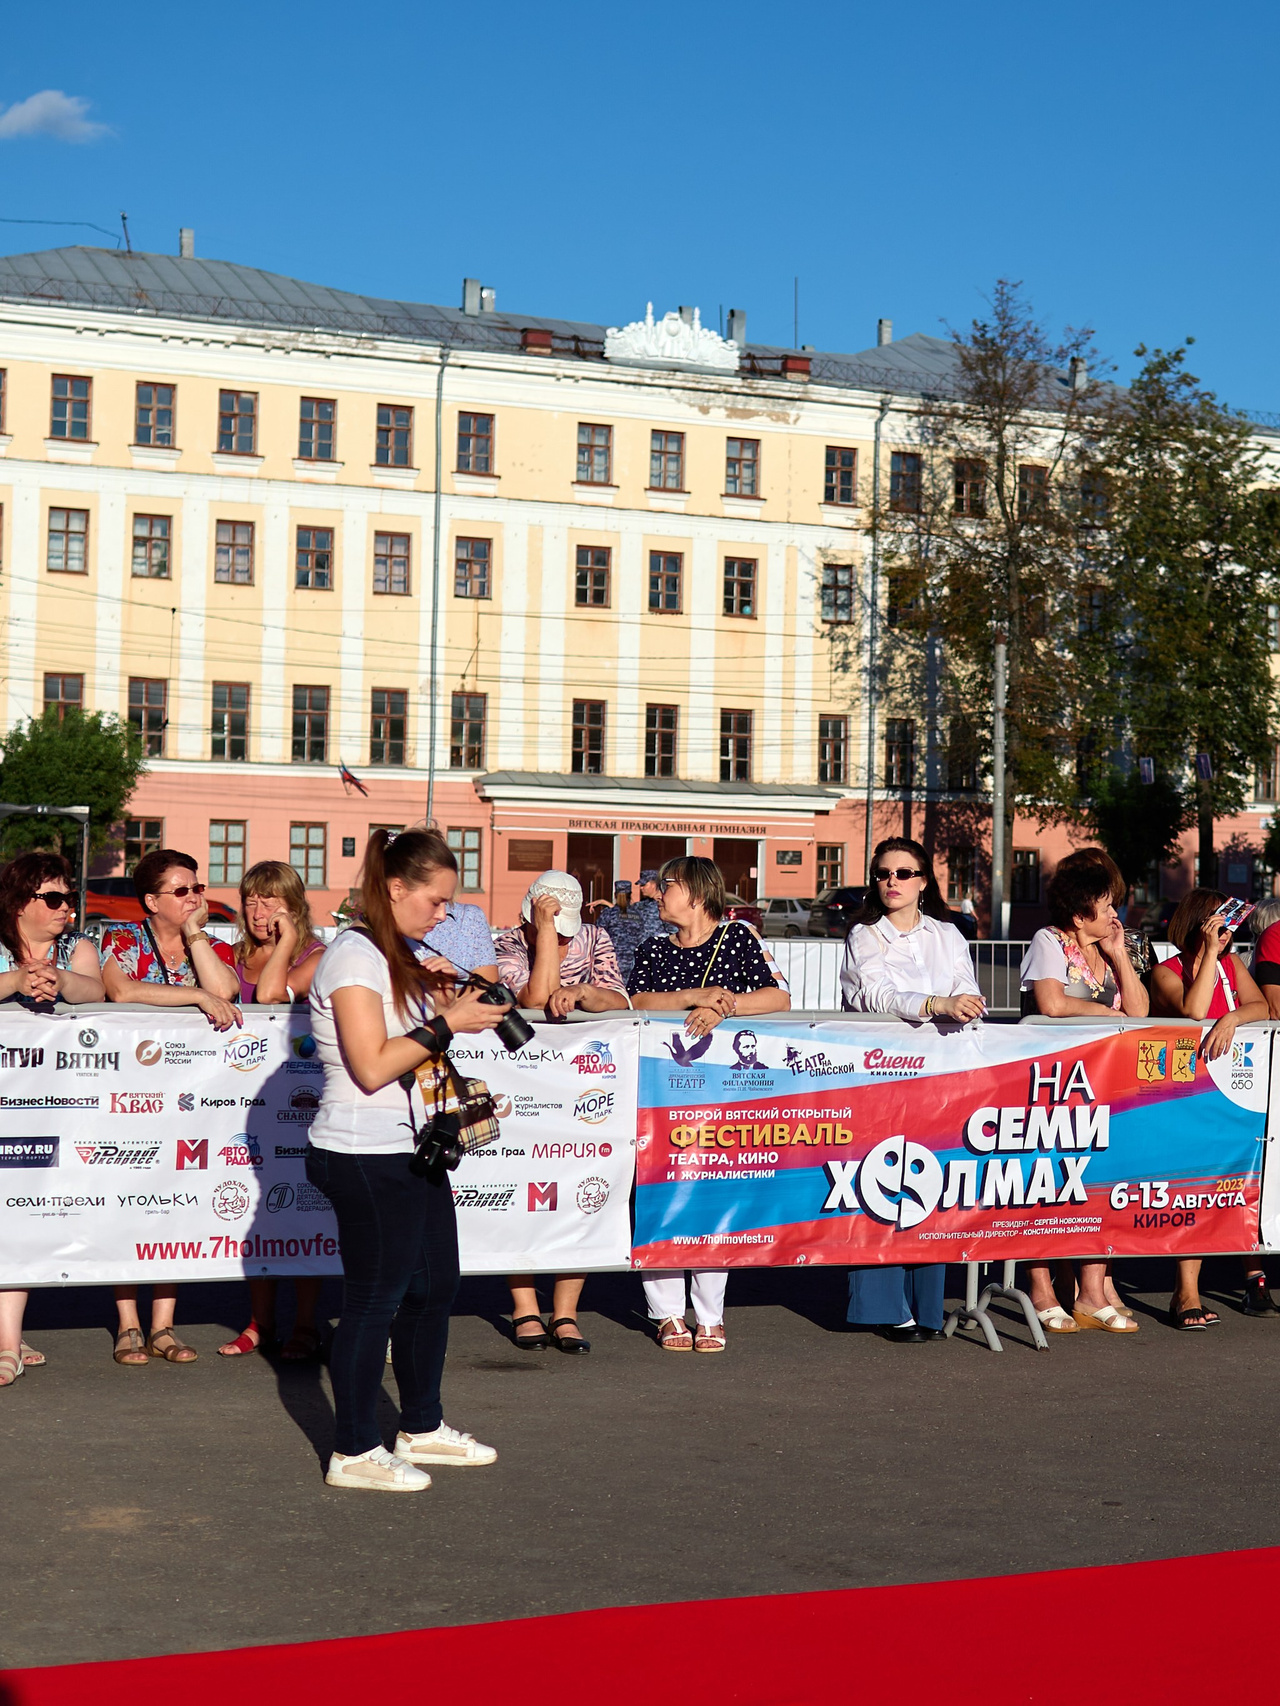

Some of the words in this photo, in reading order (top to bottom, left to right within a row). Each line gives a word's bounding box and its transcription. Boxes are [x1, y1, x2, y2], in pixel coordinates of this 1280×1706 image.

[569, 820, 616, 829] ВЯТСКАЯ
[622, 822, 705, 832] ПРАВОСЛАВНАЯ
[710, 825, 767, 834] ГИМНАЗИЯ
[165, 1050, 216, 1058] журналистов
[224, 1038, 268, 1063] МОРЕ
[56, 1051, 120, 1071] ВЯТИЧ
[246, 1056, 267, 1066] ПАРК
[570, 1054, 599, 1065] АВТО
[789, 1052, 826, 1076] ТЕАТР
[863, 1048, 925, 1069] Смена
[281, 1061, 324, 1069] ПЕРВЫ
[579, 1064, 616, 1074] РАДИО
[810, 1063, 855, 1077] СПАССКОЙ
[668, 1079, 705, 1088] ТЕАТР
[1030, 1060, 1096, 1103] НА
[1231, 1080, 1253, 1090] 650
[201, 1098, 235, 1107] Киров
[240, 1097, 266, 1107] Град
[514, 1094, 533, 1102] Союз
[515, 1102, 562, 1110] журналистов
[573, 1092, 614, 1116] МОРЕ
[277, 1112, 316, 1120] CHARUS
[595, 1108, 612, 1118] ПАРК
[669, 1109, 722, 1121] ВТОРОЙ
[725, 1108, 779, 1120] ВЯТСКИЙ
[781, 1107, 852, 1119] ОТКРЫТЫЙ
[963, 1105, 1110, 1153] СЕМИ
[670, 1123, 853, 1148] ФЕСТИВАЛЬ
[0, 1145, 53, 1155] IROV.RU
[217, 1146, 248, 1156] АВТО
[502, 1147, 525, 1158] Град
[532, 1143, 596, 1159] МАРИЯ
[225, 1156, 263, 1166] РАДИО
[669, 1154, 734, 1166] ТЕАТРА,
[738, 1152, 779, 1164] КИНО
[667, 1171, 675, 1180] И
[681, 1169, 775, 1180] ЖУРНАЛИСТИКИ
[1110, 1181, 1169, 1210] 6-13
[1172, 1192, 1247, 1210] АВГУСТА
[1216, 1178, 1244, 1192] 2023
[992, 1220, 1029, 1228] ПРЕЗИДЕНТ
[1133, 1213, 1196, 1228] КИРОВ
[673, 1234, 774, 1245] www.7holmovfest.ru
[918, 1230, 984, 1240] ИСПОЛНИТЕЛЬНЫЙ
[985, 1230, 1018, 1238] ДИРЕКТОР
[1023, 1228, 1065, 1236] КОНСТАНТИН
[135, 1233, 342, 1260] www.7holmovfe.
